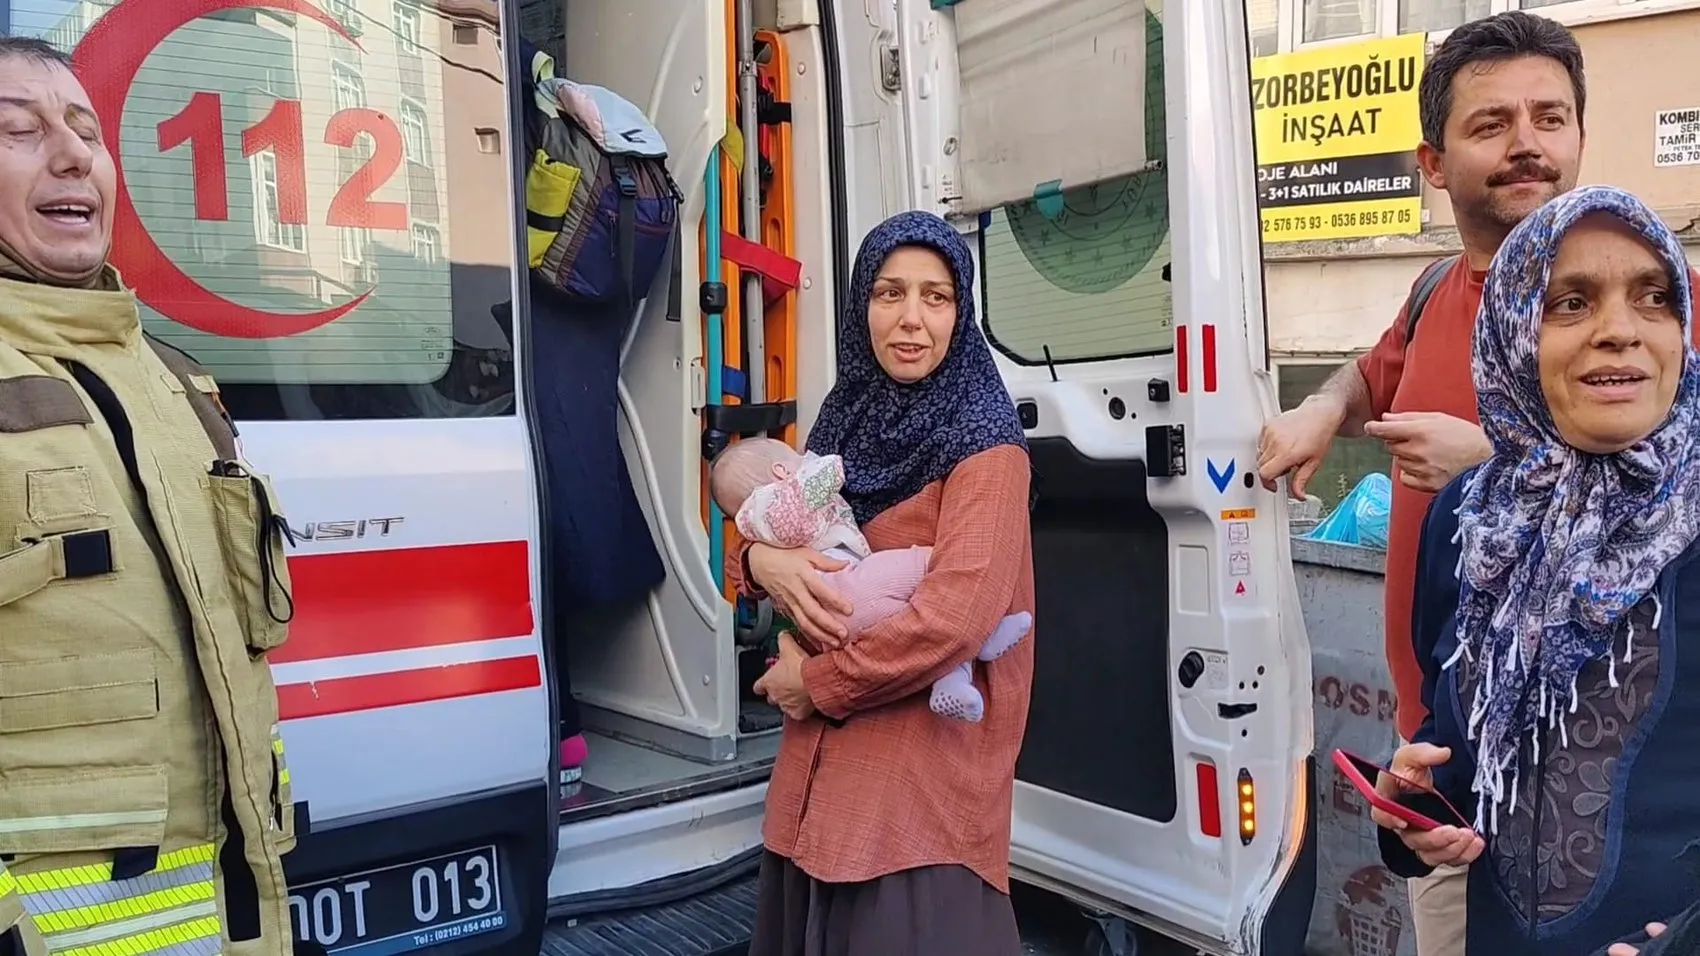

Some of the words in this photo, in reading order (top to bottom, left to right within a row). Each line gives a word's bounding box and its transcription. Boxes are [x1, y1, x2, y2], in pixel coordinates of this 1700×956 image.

[1252, 53, 1415, 110] ZORBEYOĞLU
[1282, 108, 1382, 146] İNŞAAT
[157, 91, 408, 231] 112
[1657, 151, 1683, 163] 0536
[1687, 151, 1700, 161] 70
[1289, 162, 1338, 179] ALANI
[1268, 186, 1289, 200] 3+1
[1291, 181, 1341, 198] SATILIK
[1344, 176, 1412, 194] DAİRELER
[1274, 217, 1291, 231] 576
[1294, 216, 1306, 230] 75
[1309, 215, 1321, 229] 93
[1331, 213, 1356, 228] 0536
[1359, 211, 1378, 226] 895
[1382, 210, 1394, 224] 87
[1398, 208, 1410, 223] 05
[411, 855, 491, 922] 013
[434, 924, 461, 941] (0212)
[463, 921, 479, 933] 454
[480, 919, 491, 929] 40
[492, 916, 503, 926] 00
